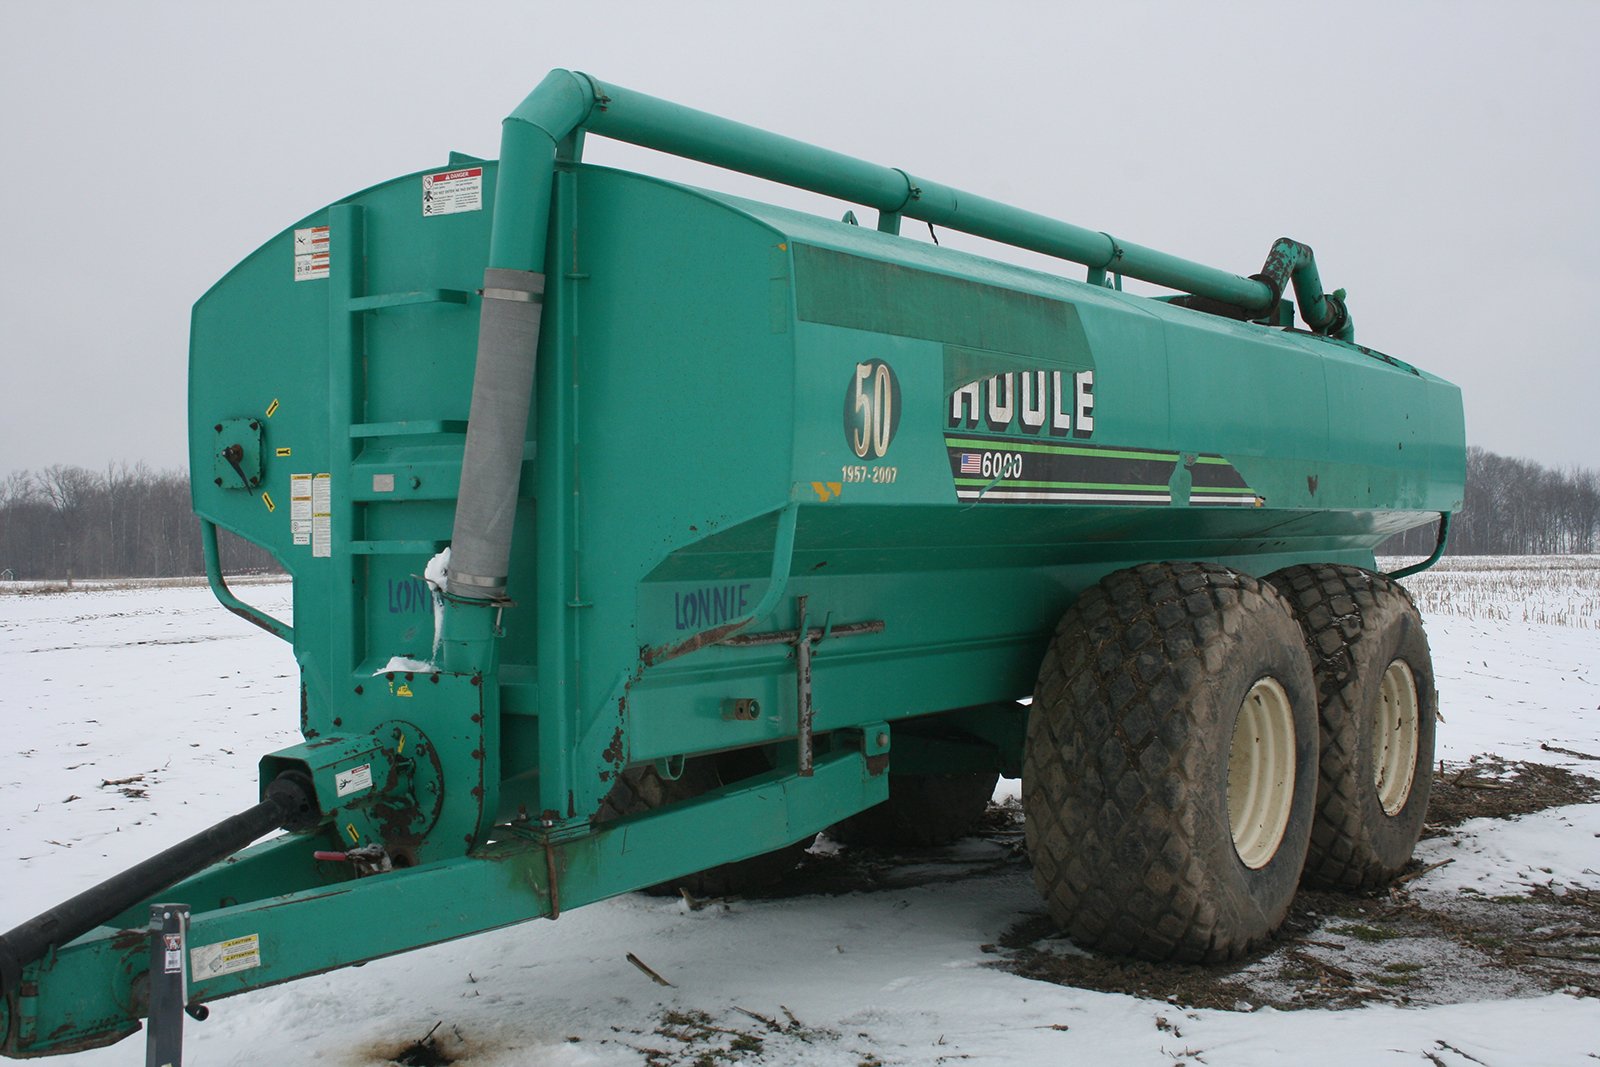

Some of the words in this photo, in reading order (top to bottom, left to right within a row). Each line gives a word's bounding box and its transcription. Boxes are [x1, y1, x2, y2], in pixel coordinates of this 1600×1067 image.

[854, 362, 892, 458] 50
[842, 465, 898, 484] 1957-2007
[982, 452, 1022, 478] 6000
[675, 584, 751, 630] LONNIE
[232, 937, 252, 945] CAUTION
[231, 950, 255, 959] ATTENTION
